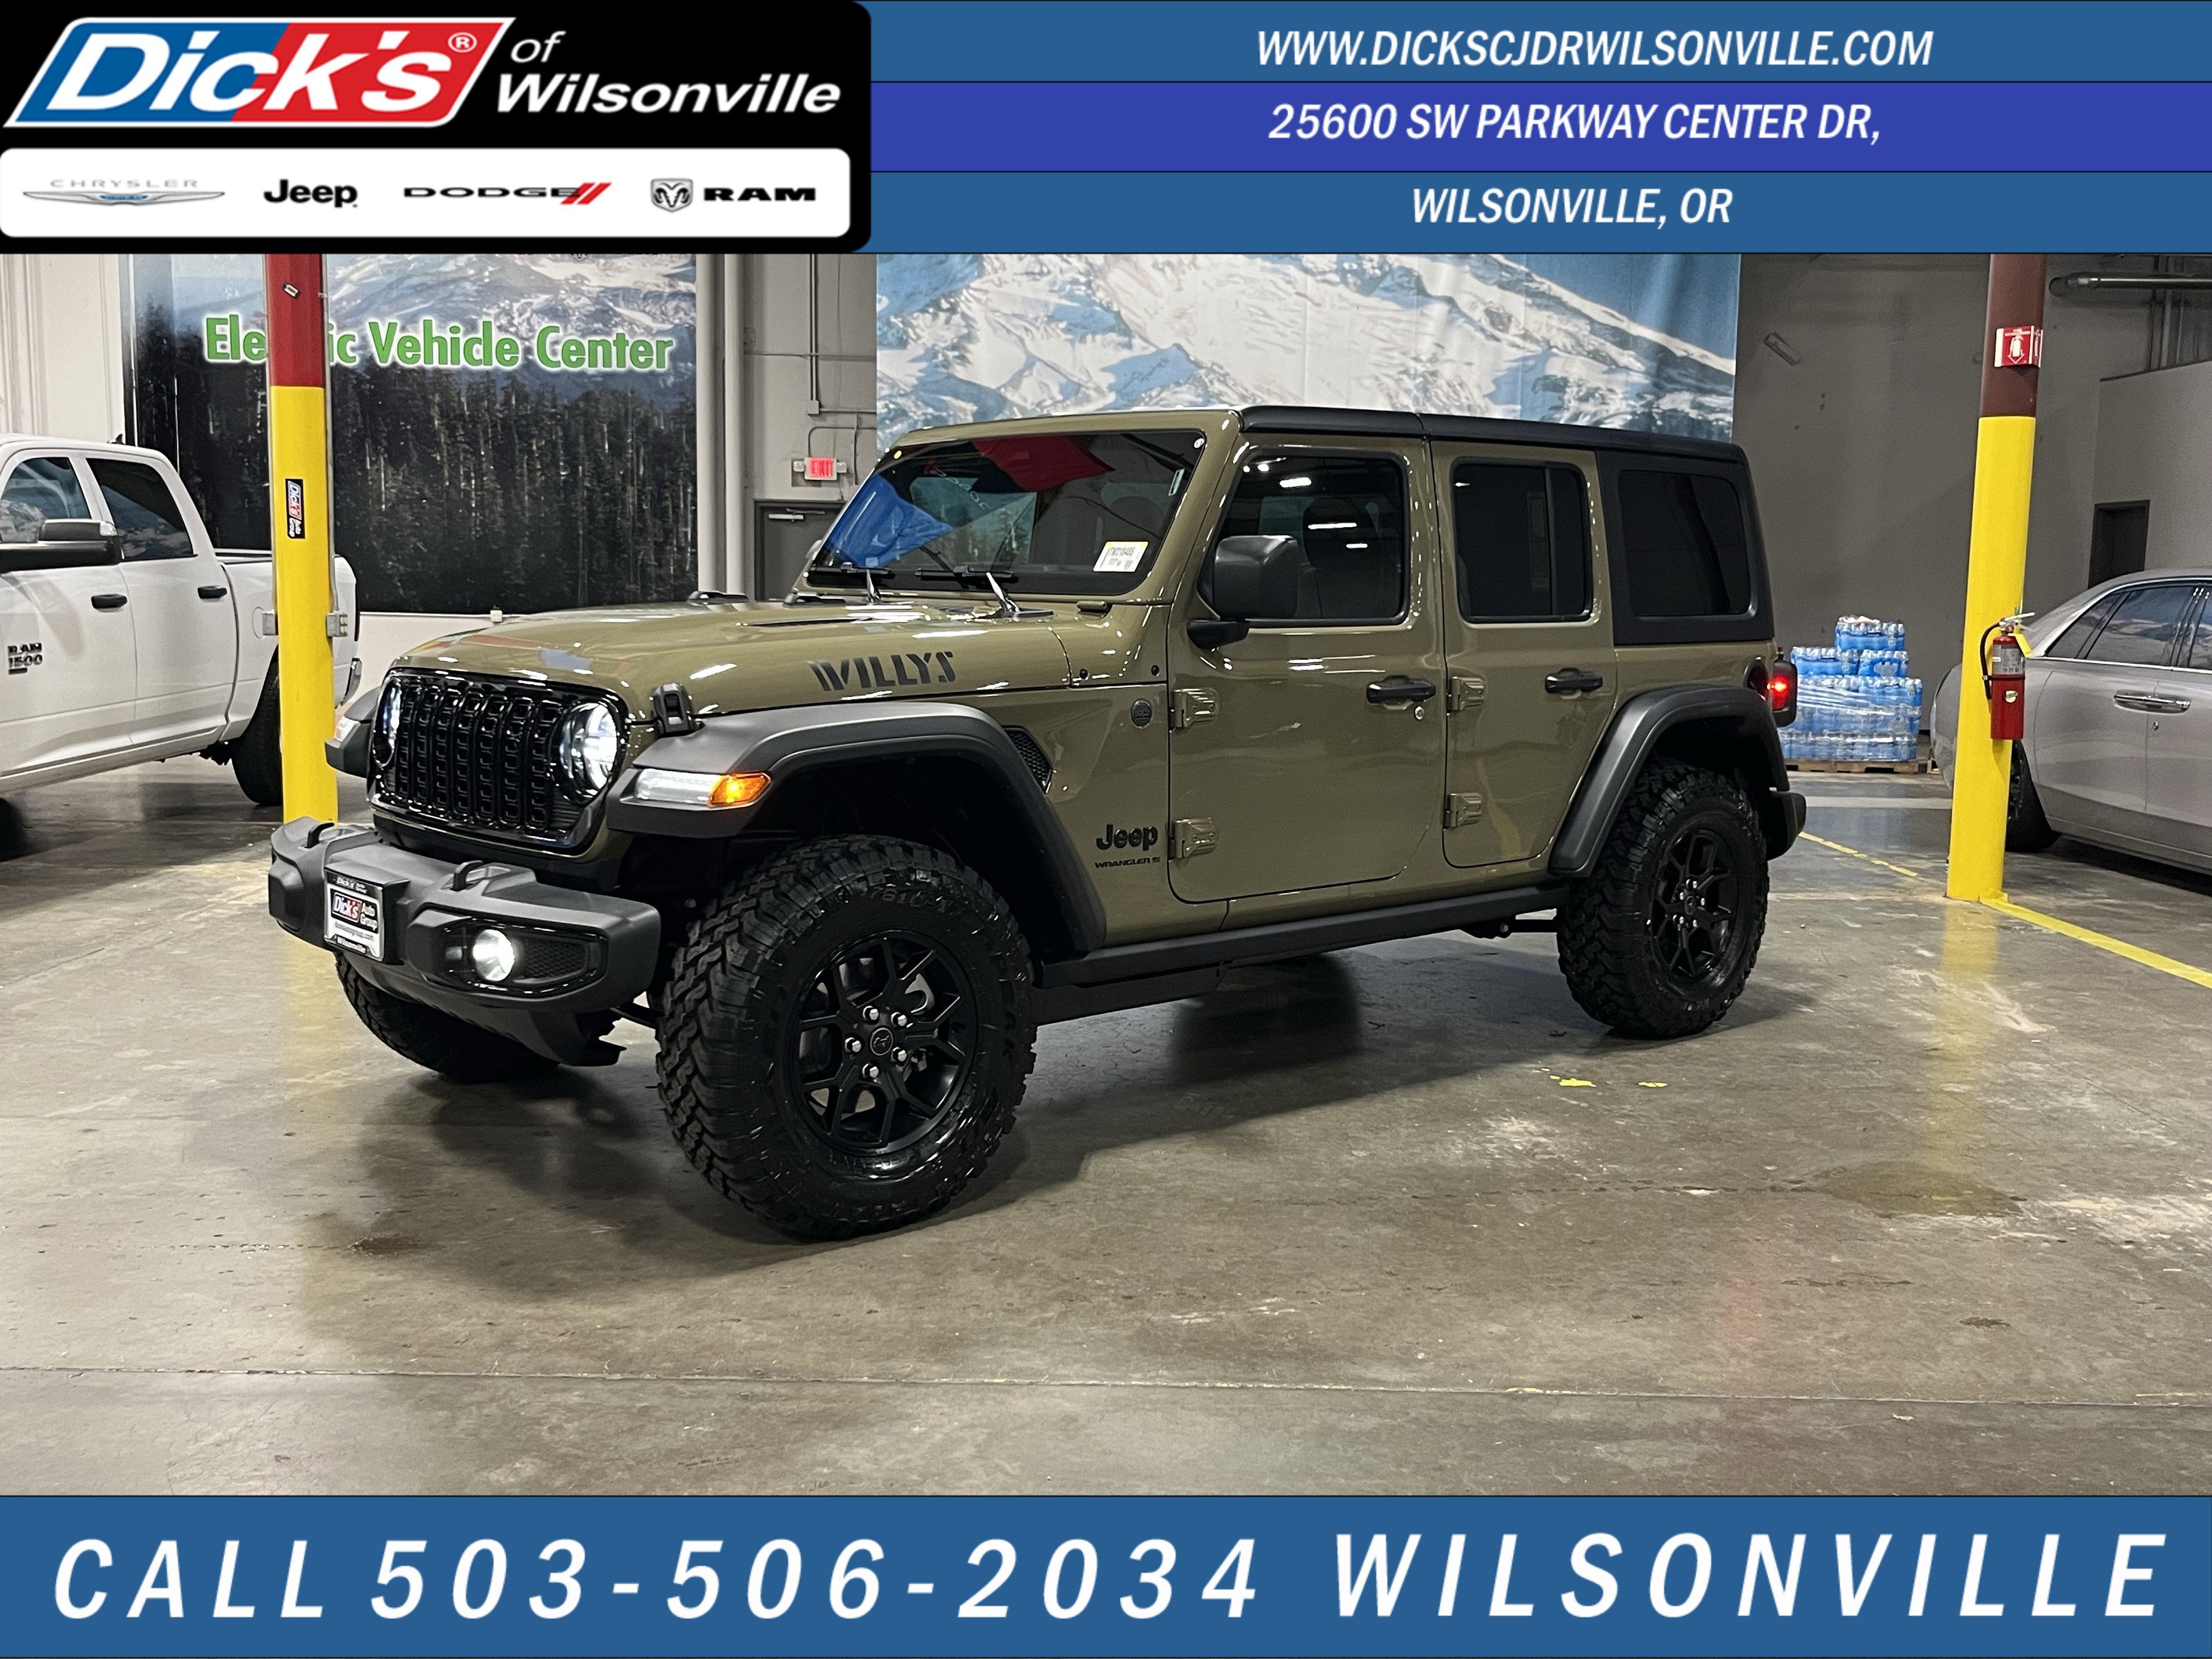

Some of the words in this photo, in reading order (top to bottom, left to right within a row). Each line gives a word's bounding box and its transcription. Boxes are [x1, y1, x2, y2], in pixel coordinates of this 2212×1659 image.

[206, 314, 357, 363] Eleic
[368, 319, 519, 367] Vehicle
[537, 325, 672, 369] Center
[8, 642, 42, 656] RAM
[8, 654, 43, 667] 1500
[808, 651, 956, 691] WILLYS
[1096, 824, 1158, 851] Jeep
[1094, 857, 1150, 868] WRANGLER
